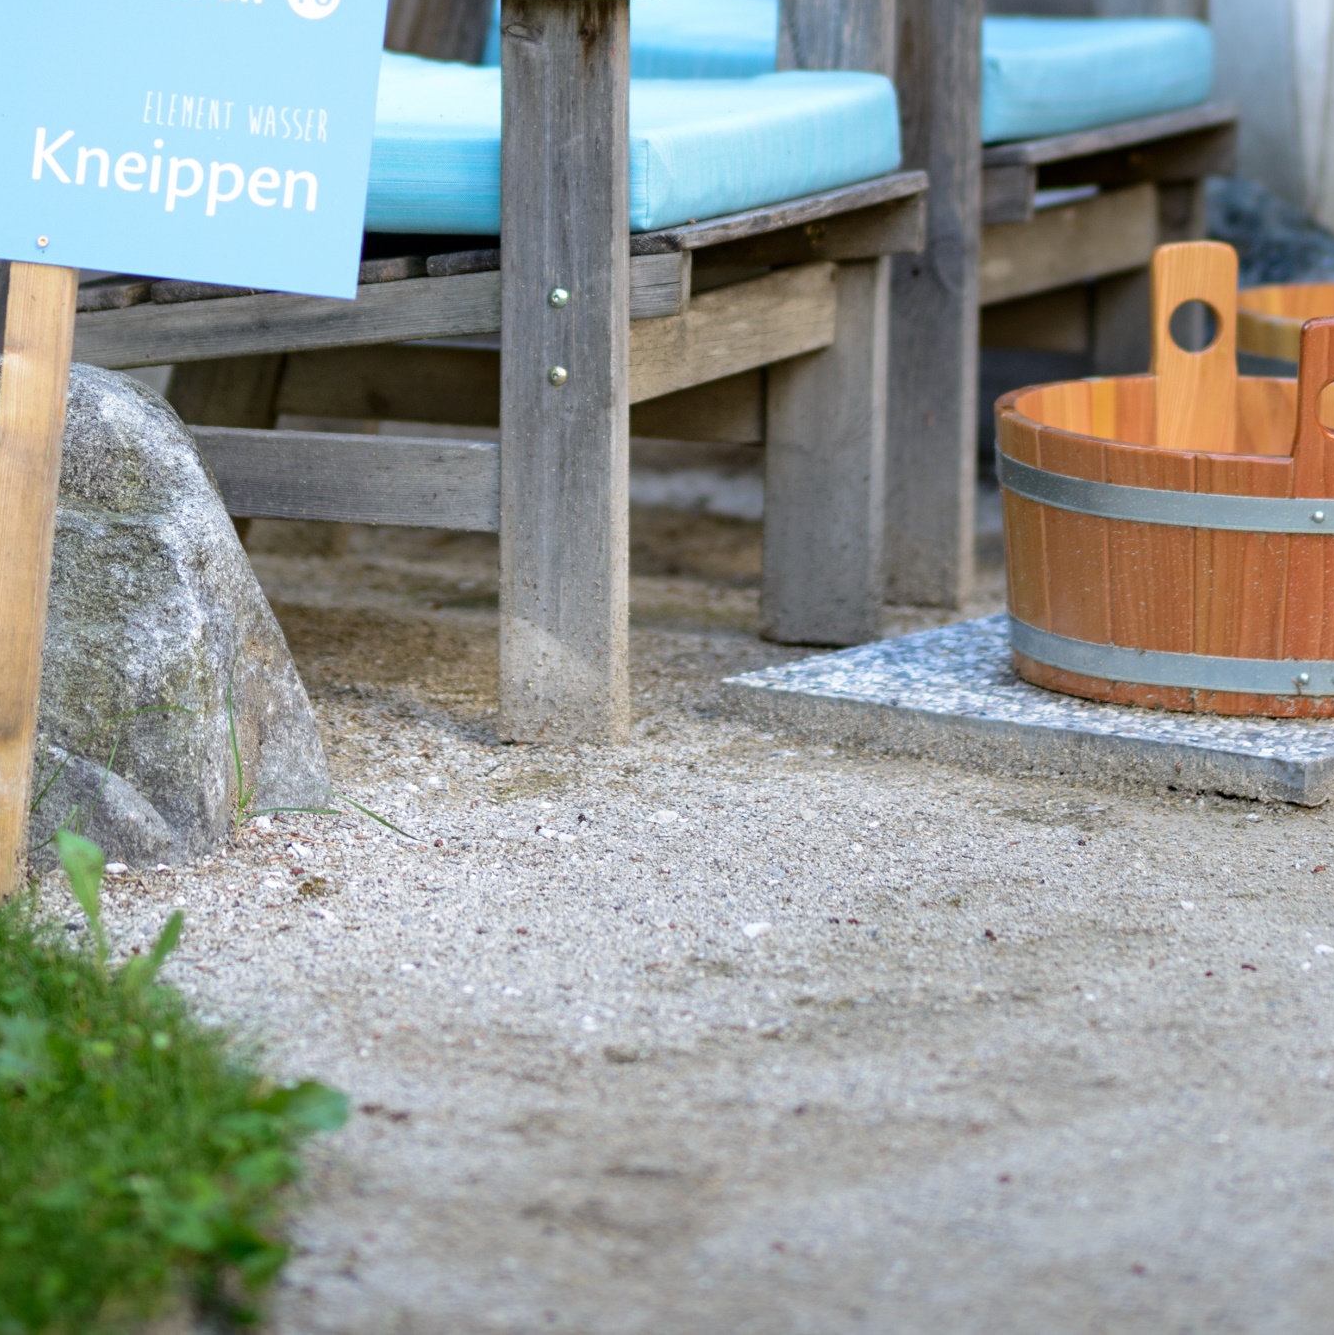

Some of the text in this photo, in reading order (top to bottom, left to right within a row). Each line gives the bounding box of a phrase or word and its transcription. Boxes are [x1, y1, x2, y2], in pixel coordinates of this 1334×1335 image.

[143, 90, 328, 143] ELEMENT WASSER
[31, 126, 319, 217] Kneippen
